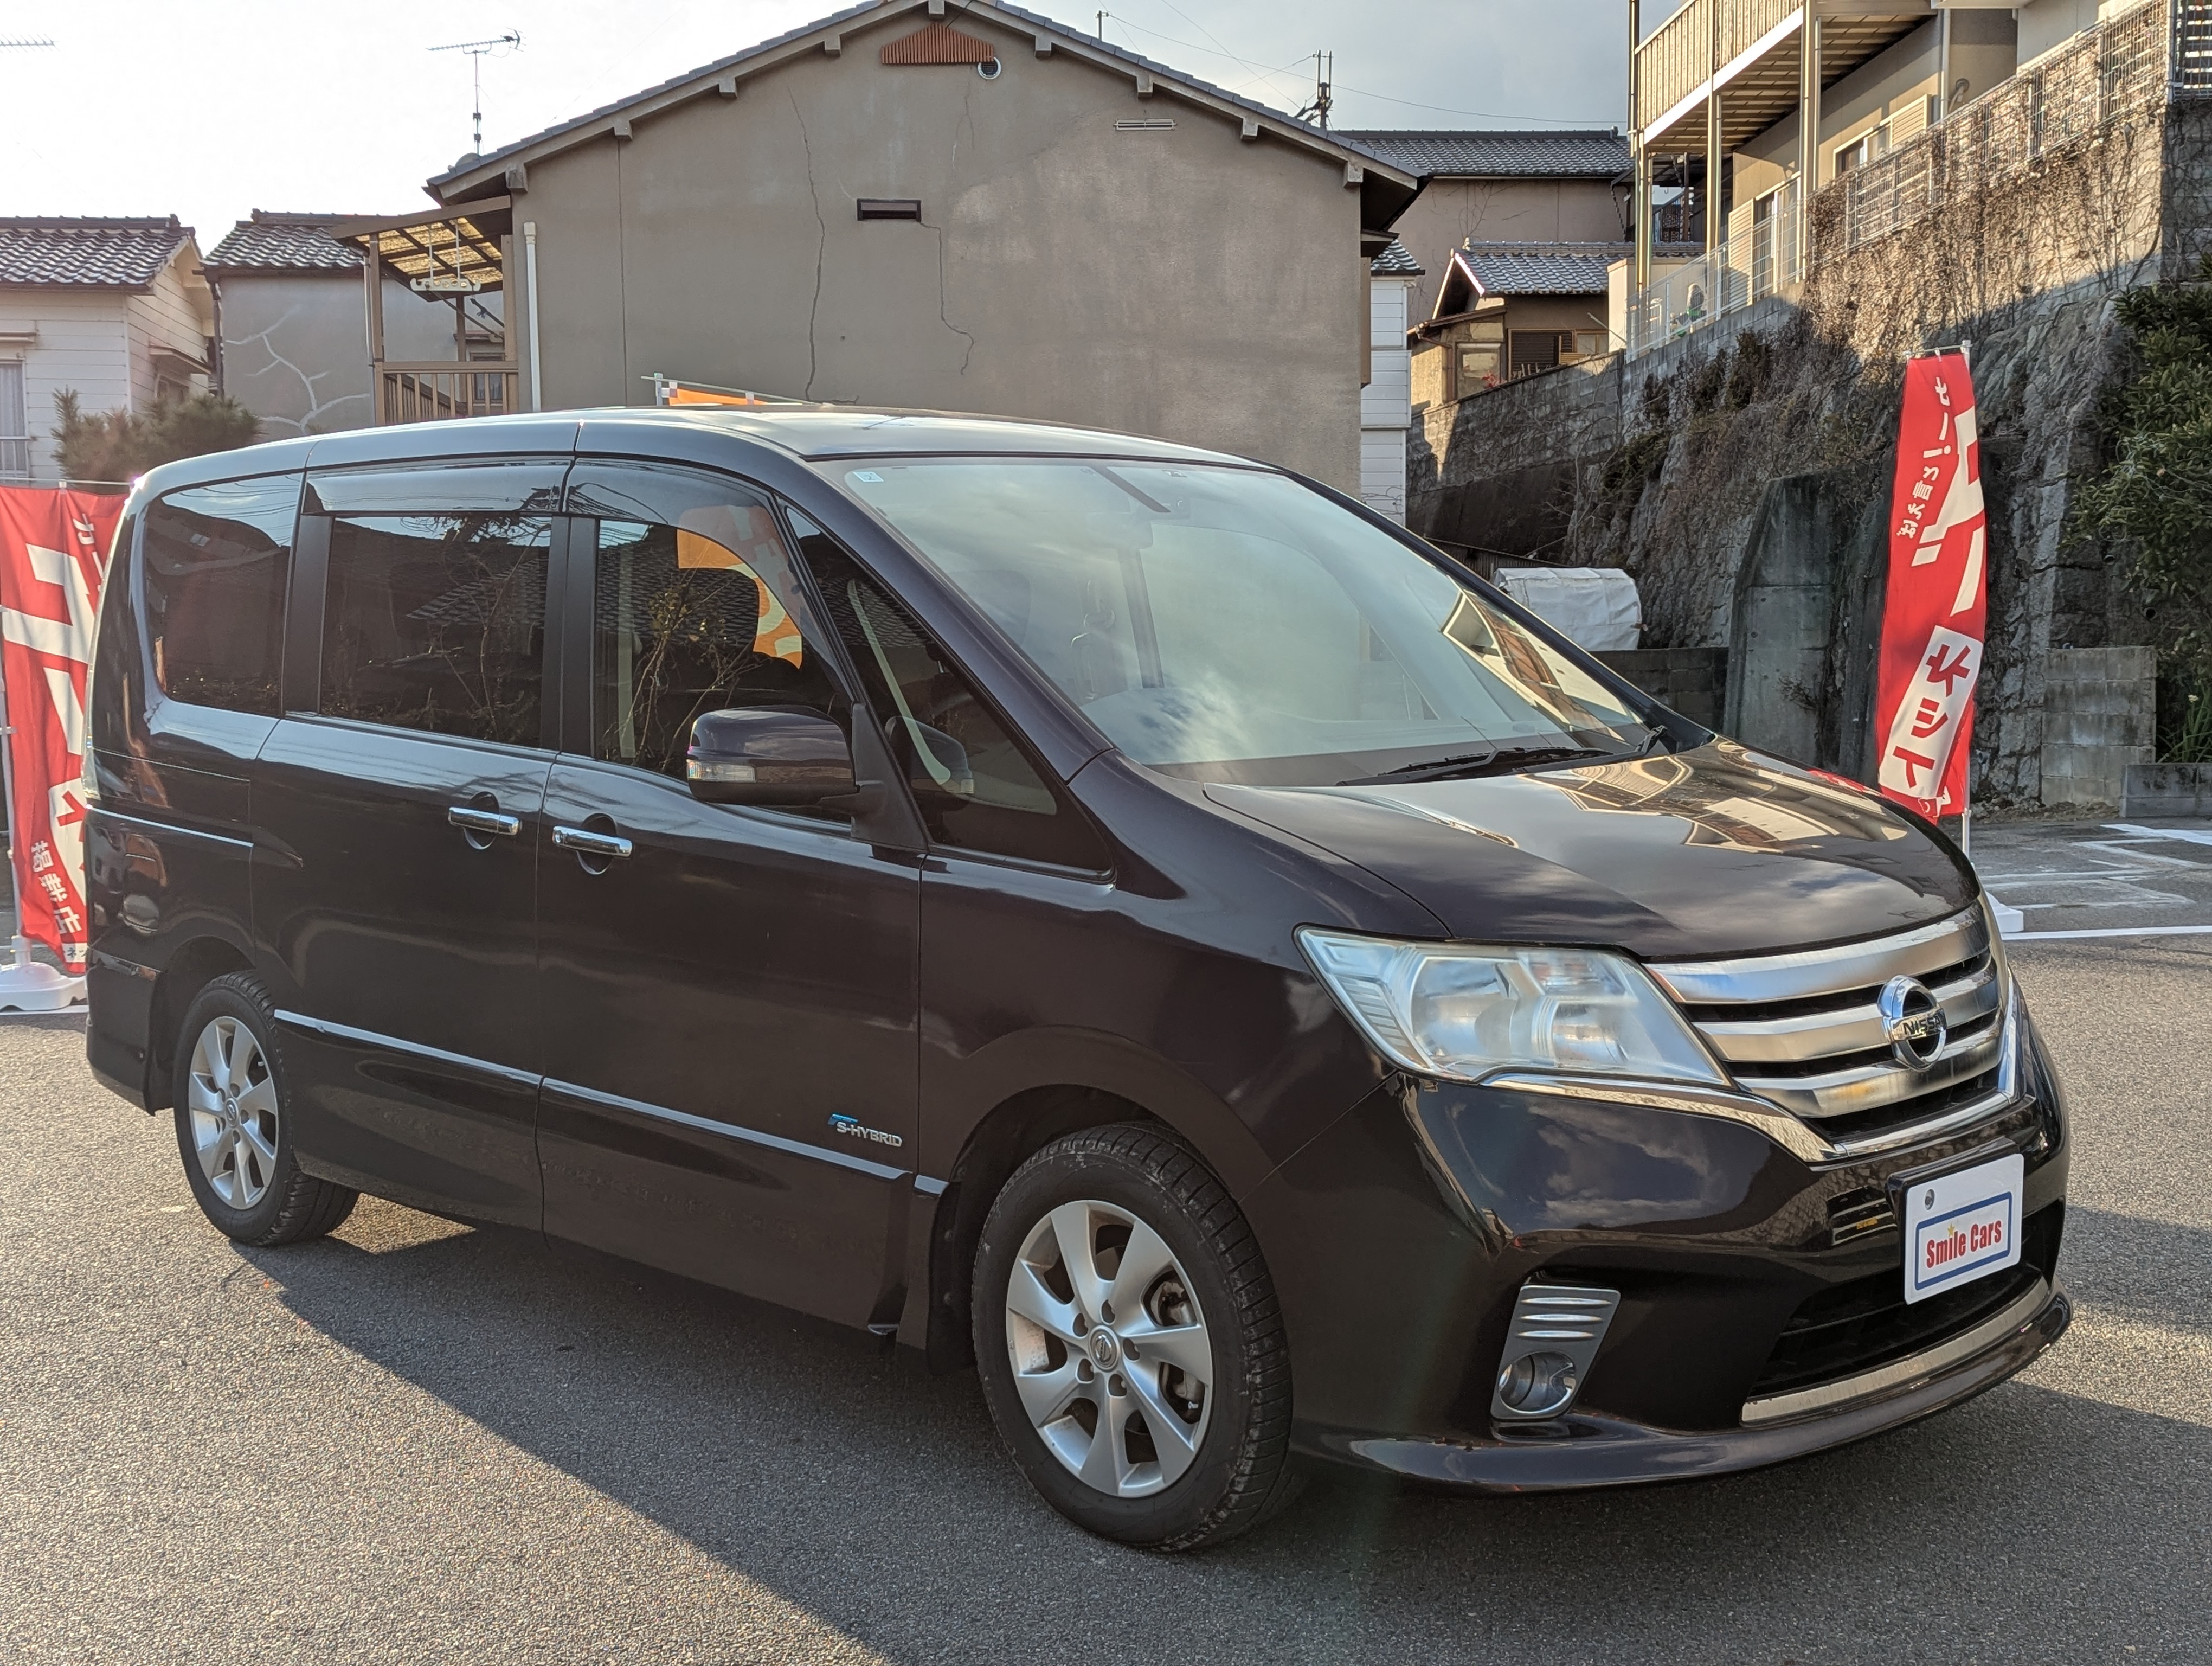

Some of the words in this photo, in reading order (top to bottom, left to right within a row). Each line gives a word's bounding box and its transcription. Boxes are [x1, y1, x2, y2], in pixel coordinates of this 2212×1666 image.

[31, 840, 82, 934] 掲載店
[837, 1122, 903, 1148] S-HYBRID
[1926, 1230, 1966, 1268] Smile
[1970, 1220, 2002, 1252] Cars
